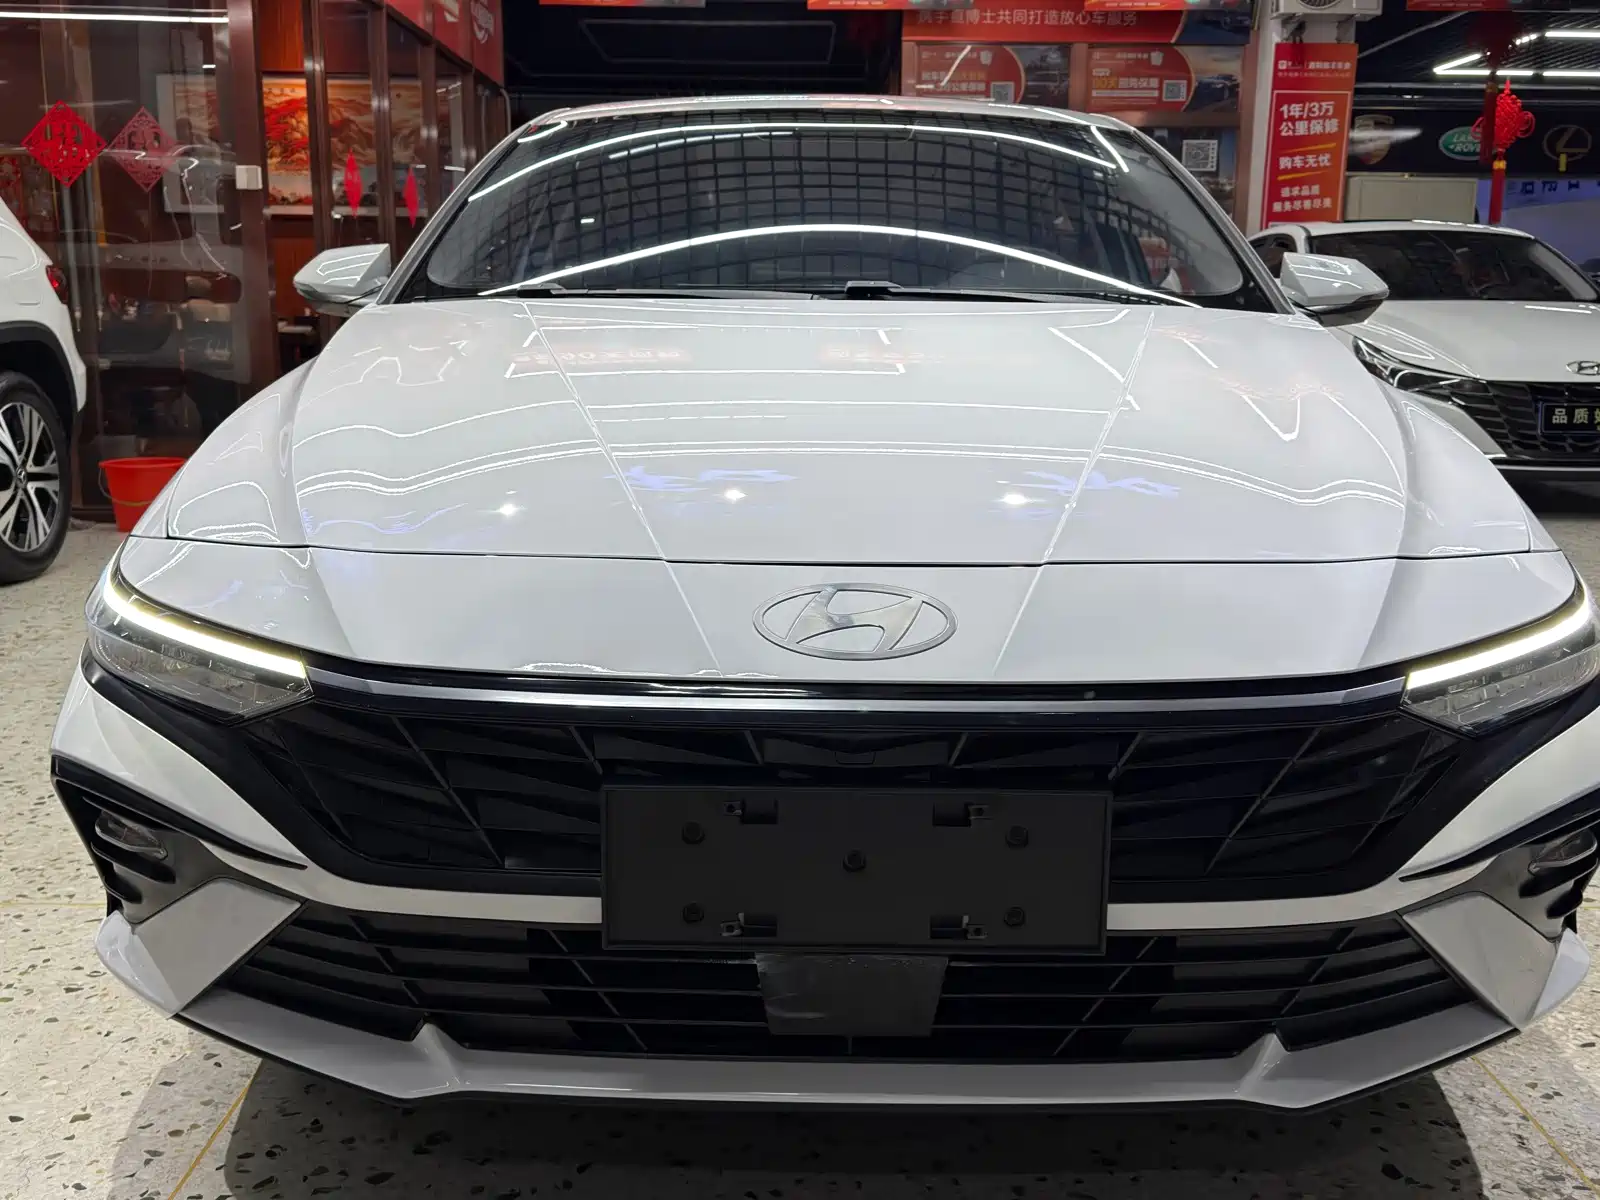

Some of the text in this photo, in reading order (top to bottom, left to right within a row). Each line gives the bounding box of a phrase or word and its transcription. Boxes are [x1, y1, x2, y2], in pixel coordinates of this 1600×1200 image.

[1280, 101, 1335, 119] 1年/3万
[1279, 118, 1340, 136] 公里保修
[1278, 153, 1331, 170] 购车无忧
